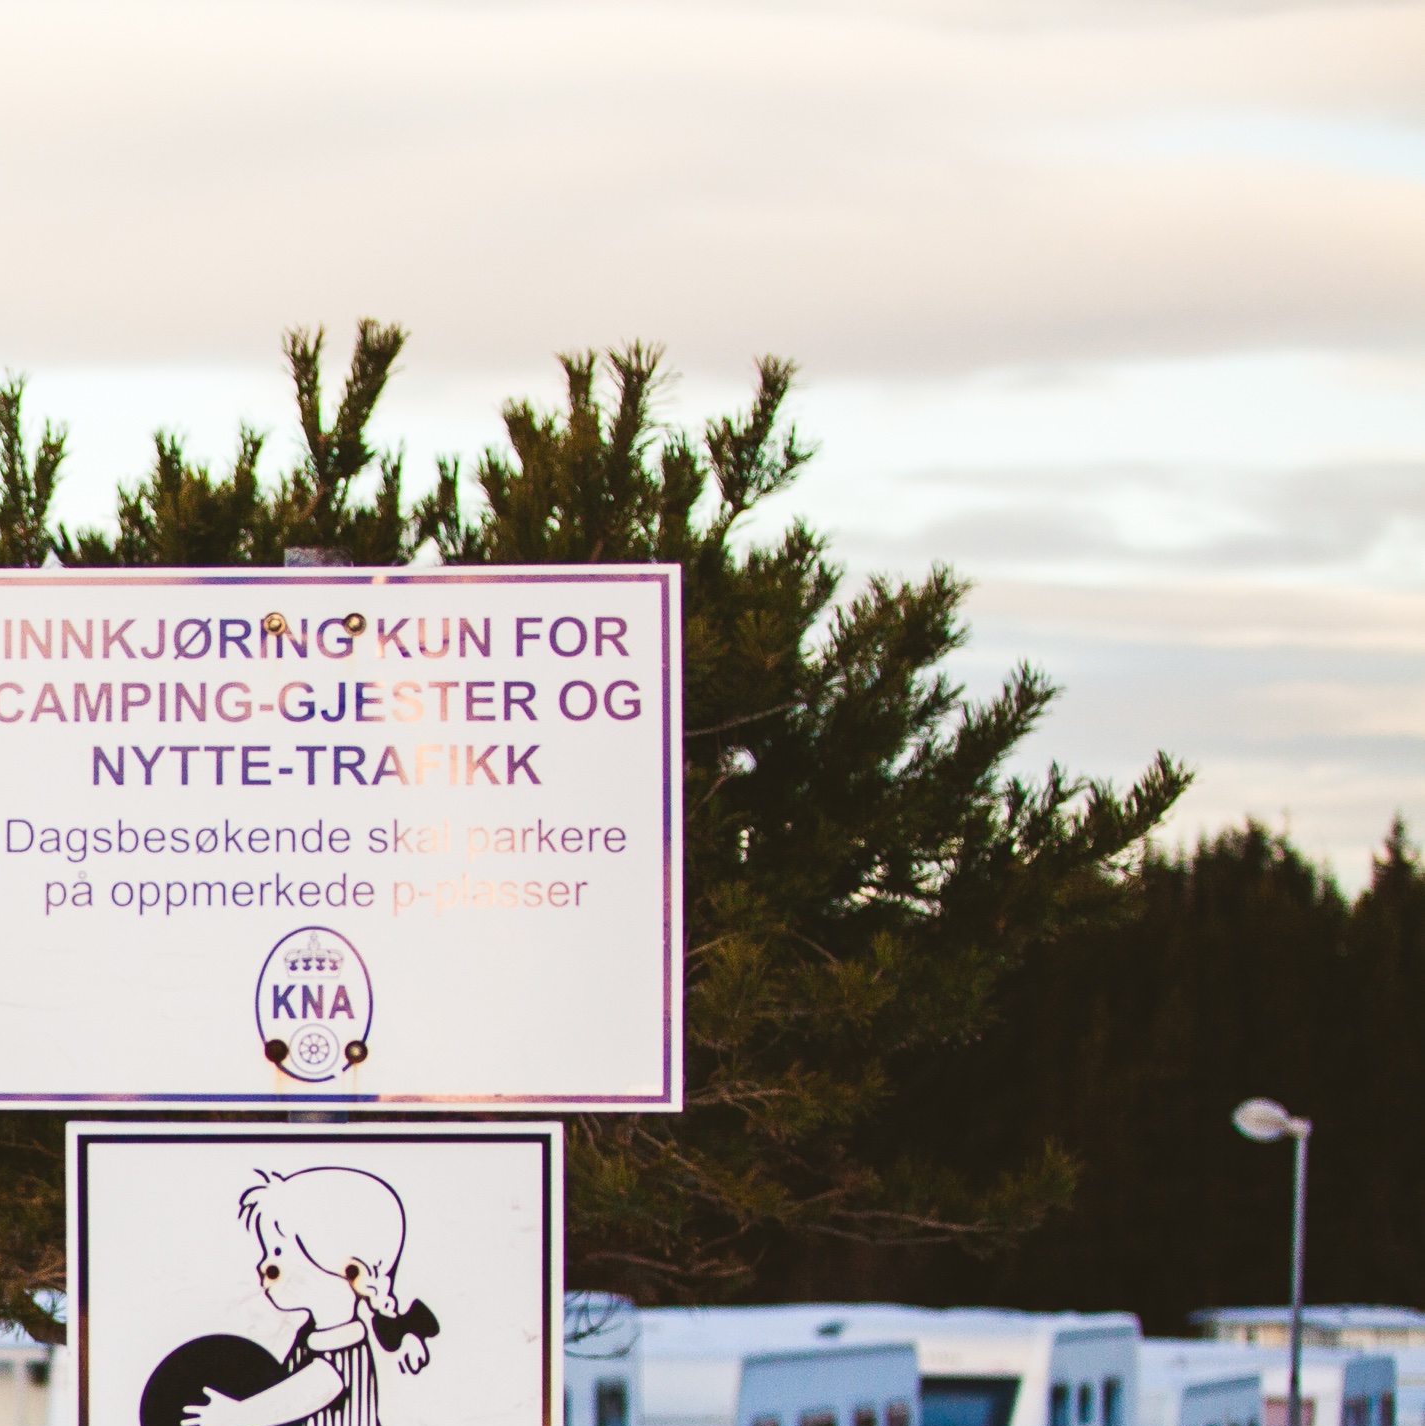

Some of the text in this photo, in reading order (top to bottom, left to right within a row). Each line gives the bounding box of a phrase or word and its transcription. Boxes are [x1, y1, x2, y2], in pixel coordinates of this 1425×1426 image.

[2, 616, 631, 661] INNKJØRING KUN FOR
[558, 679, 643, 722] OG
[91, 743, 542, 787] NYTTE-TRAFIKK
[5, 818, 628, 863] Dagsbesøkende skal parkere
[45, 870, 589, 917] på oppmerkede p-plasser
[272, 983, 356, 1020] KNA
